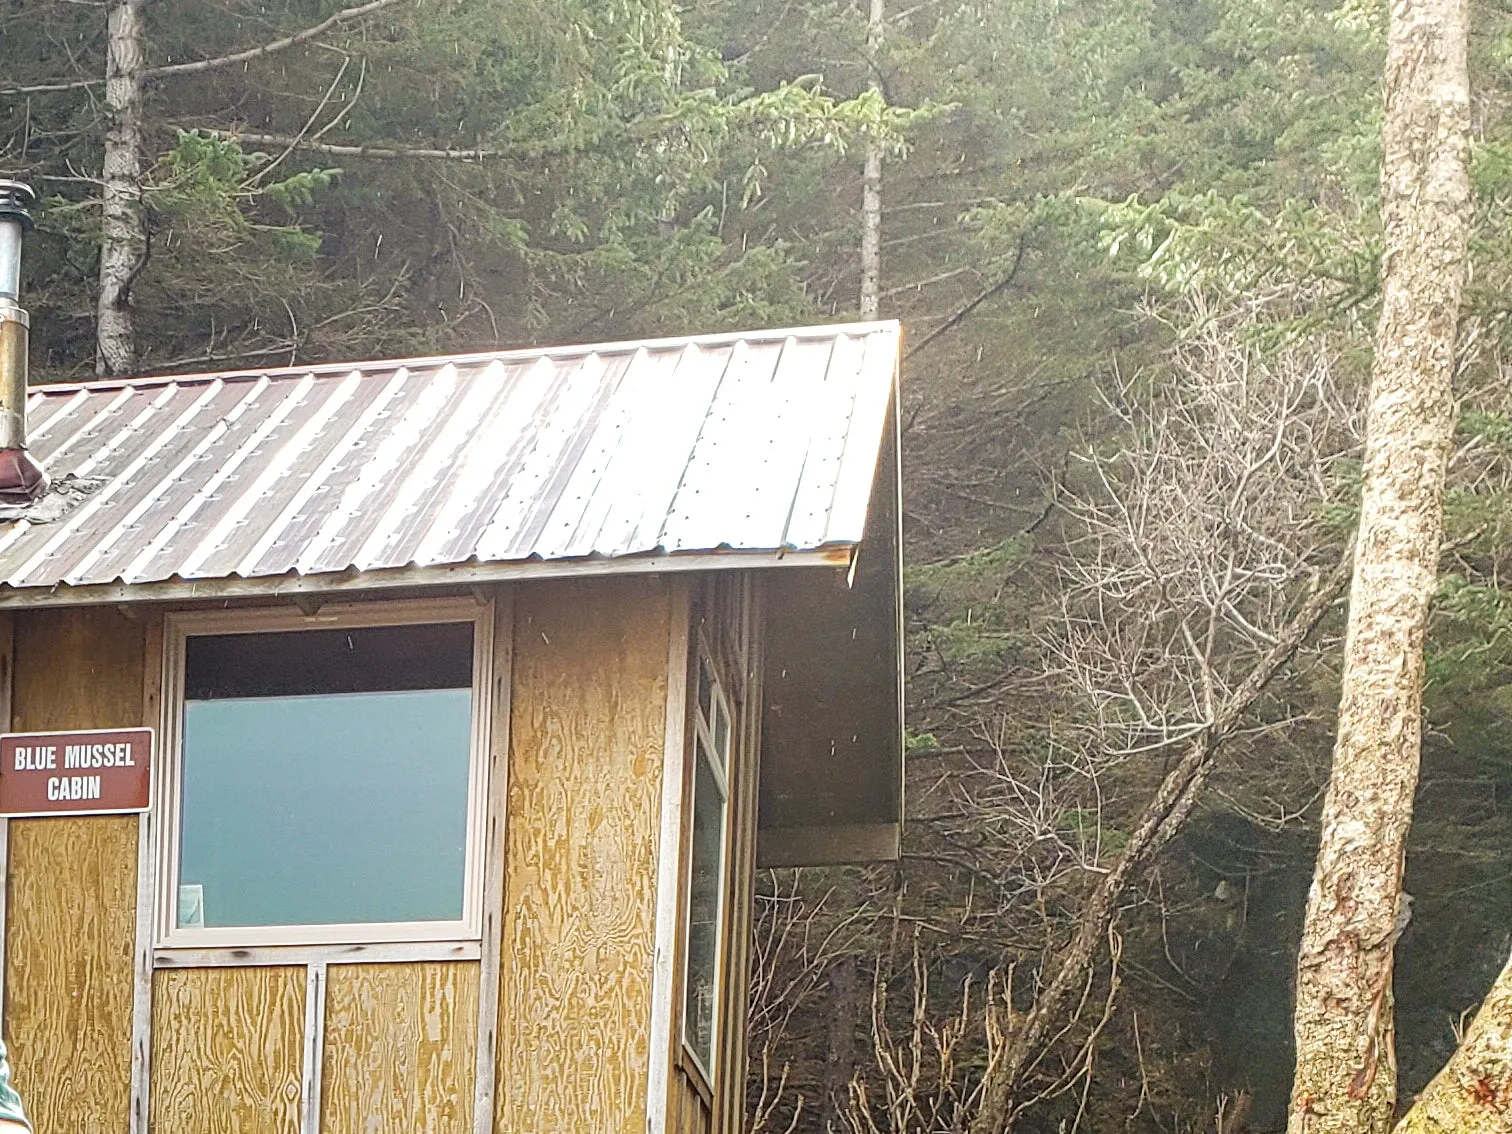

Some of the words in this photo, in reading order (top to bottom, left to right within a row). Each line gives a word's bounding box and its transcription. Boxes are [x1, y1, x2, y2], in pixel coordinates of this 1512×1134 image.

[14, 746, 57, 771] BLUE
[64, 743, 135, 769] MUSSEL
[47, 775, 101, 801] CABIN
